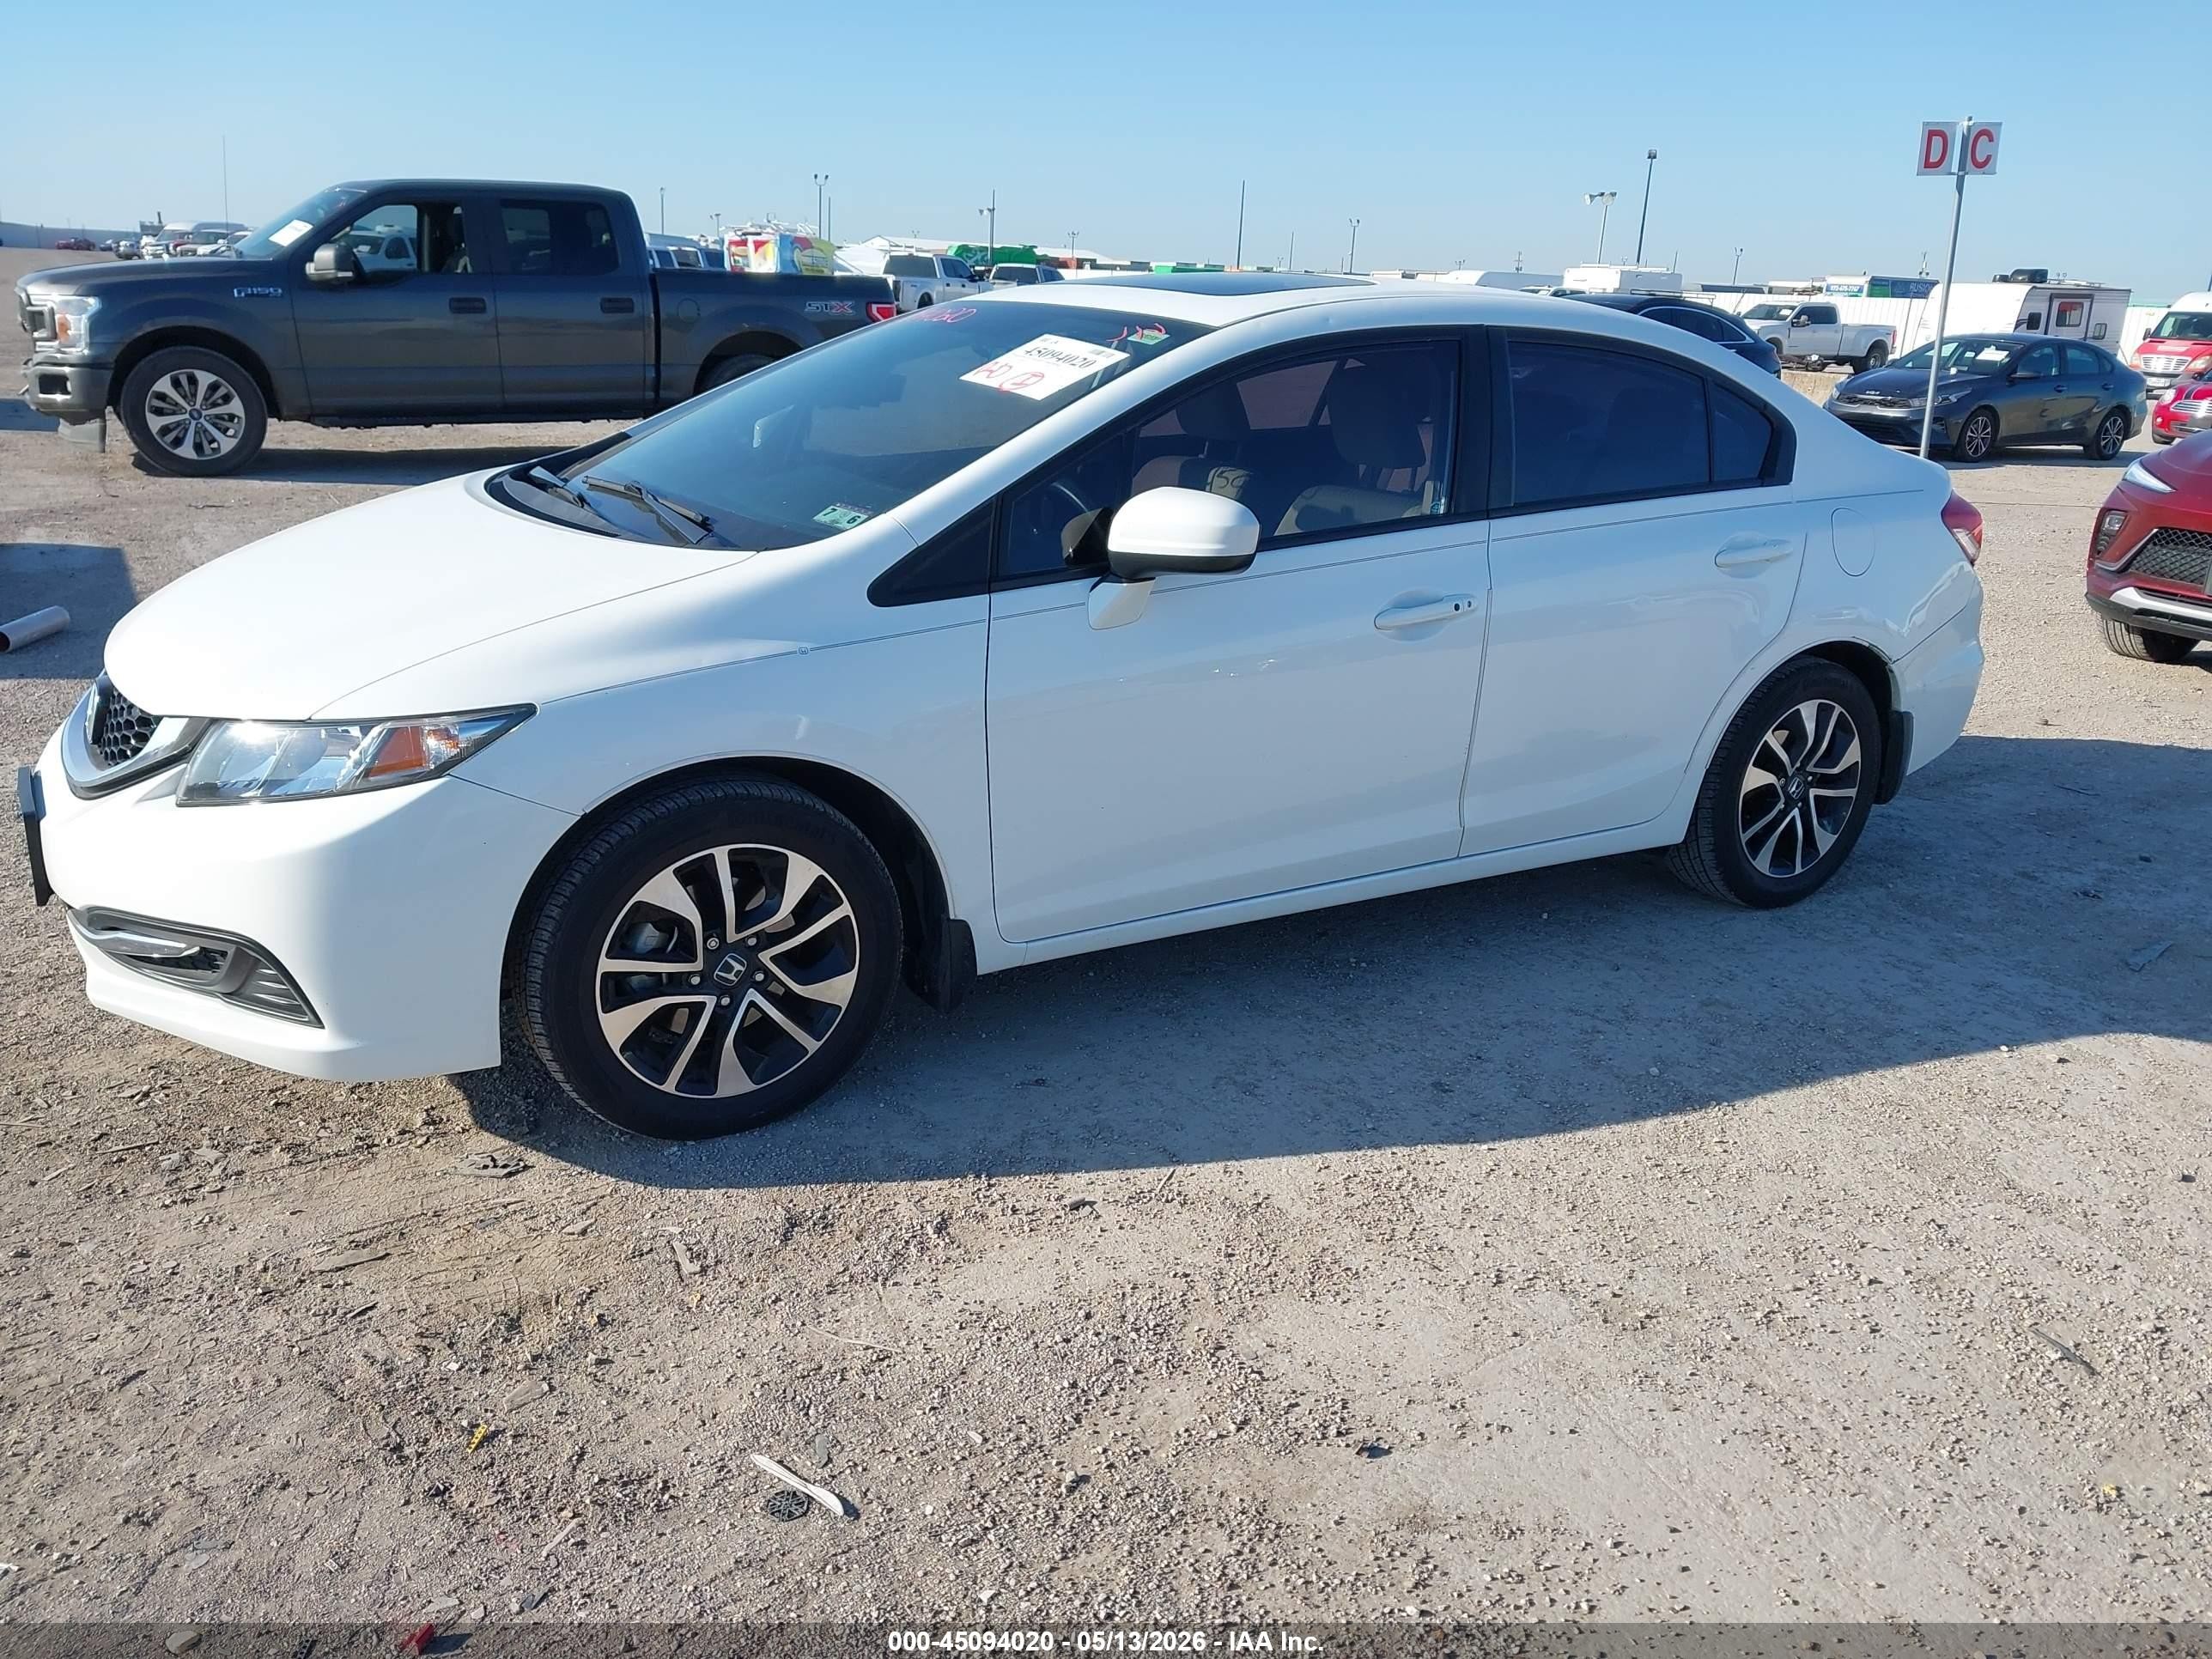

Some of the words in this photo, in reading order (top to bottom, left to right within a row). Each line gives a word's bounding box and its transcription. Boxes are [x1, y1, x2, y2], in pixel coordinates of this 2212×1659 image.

[1923, 129, 1948, 169] D
[1971, 128, 1994, 169] C
[805, 301, 854, 314] STX
[1024, 346, 1097, 369] 45094020
